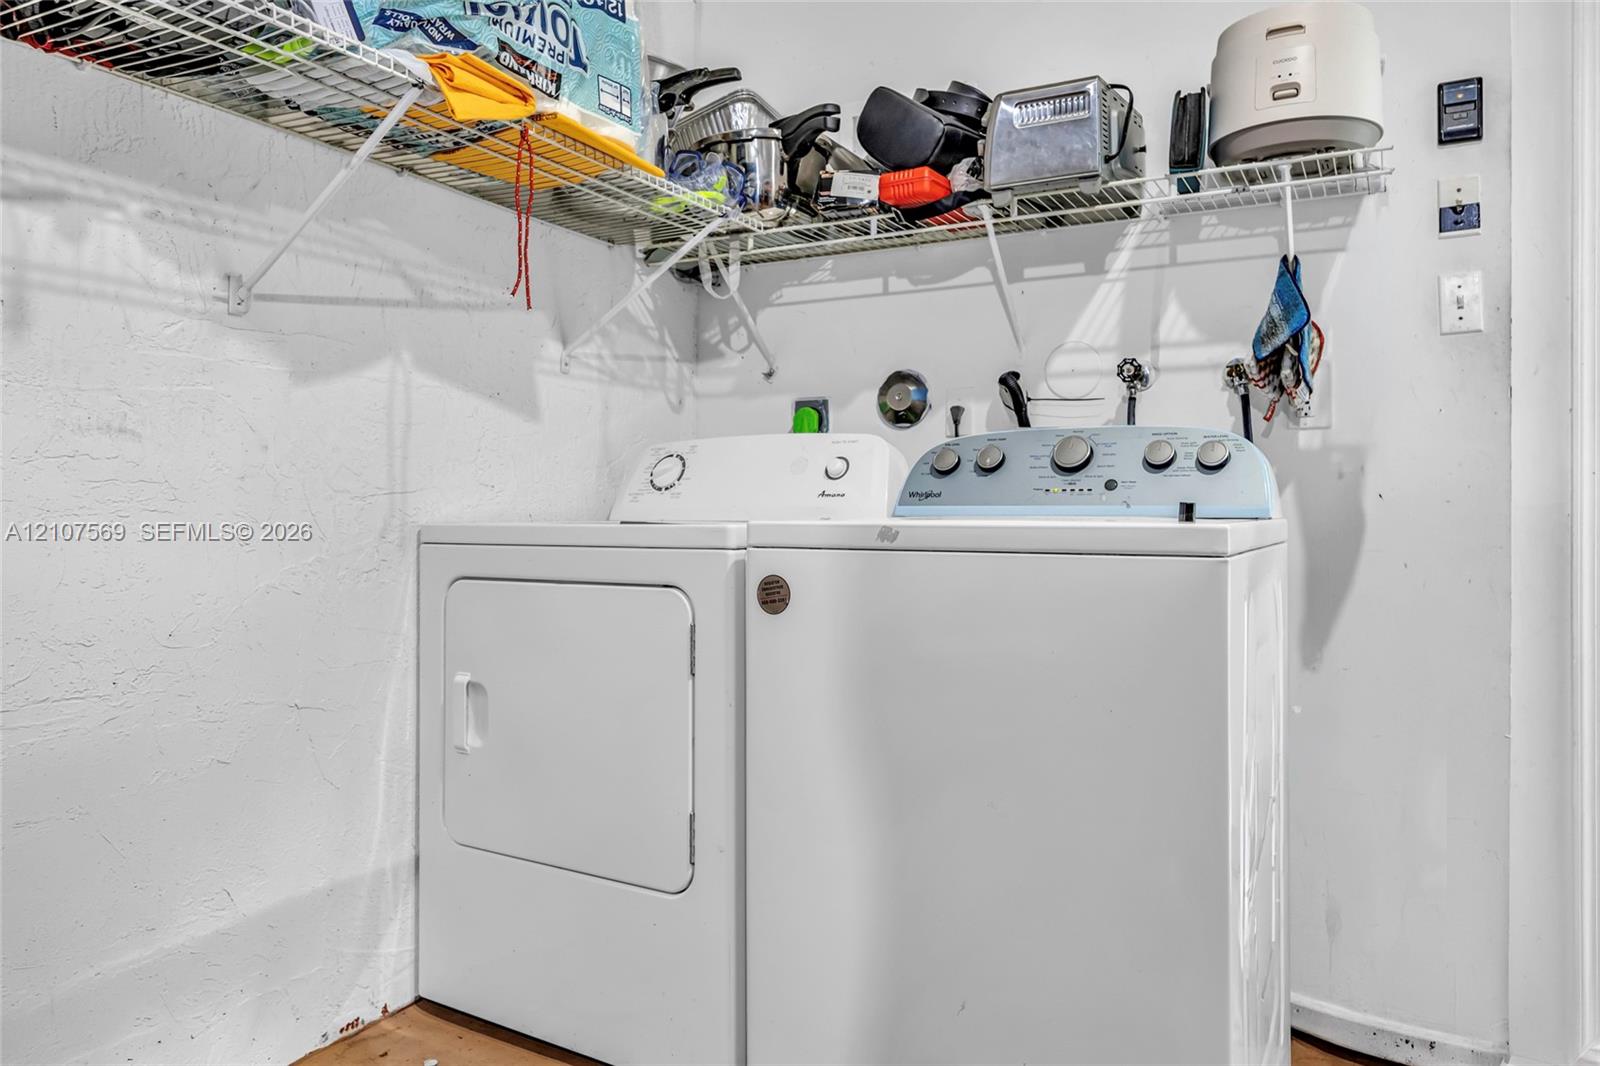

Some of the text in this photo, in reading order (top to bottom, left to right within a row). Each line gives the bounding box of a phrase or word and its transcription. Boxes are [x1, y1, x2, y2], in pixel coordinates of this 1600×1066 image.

[488, 17, 565, 65] PREMIUM
[500, 51, 558, 96] KIRKAND
[817, 490, 846, 498] Amana
[908, 490, 942, 502] Whirlpool
